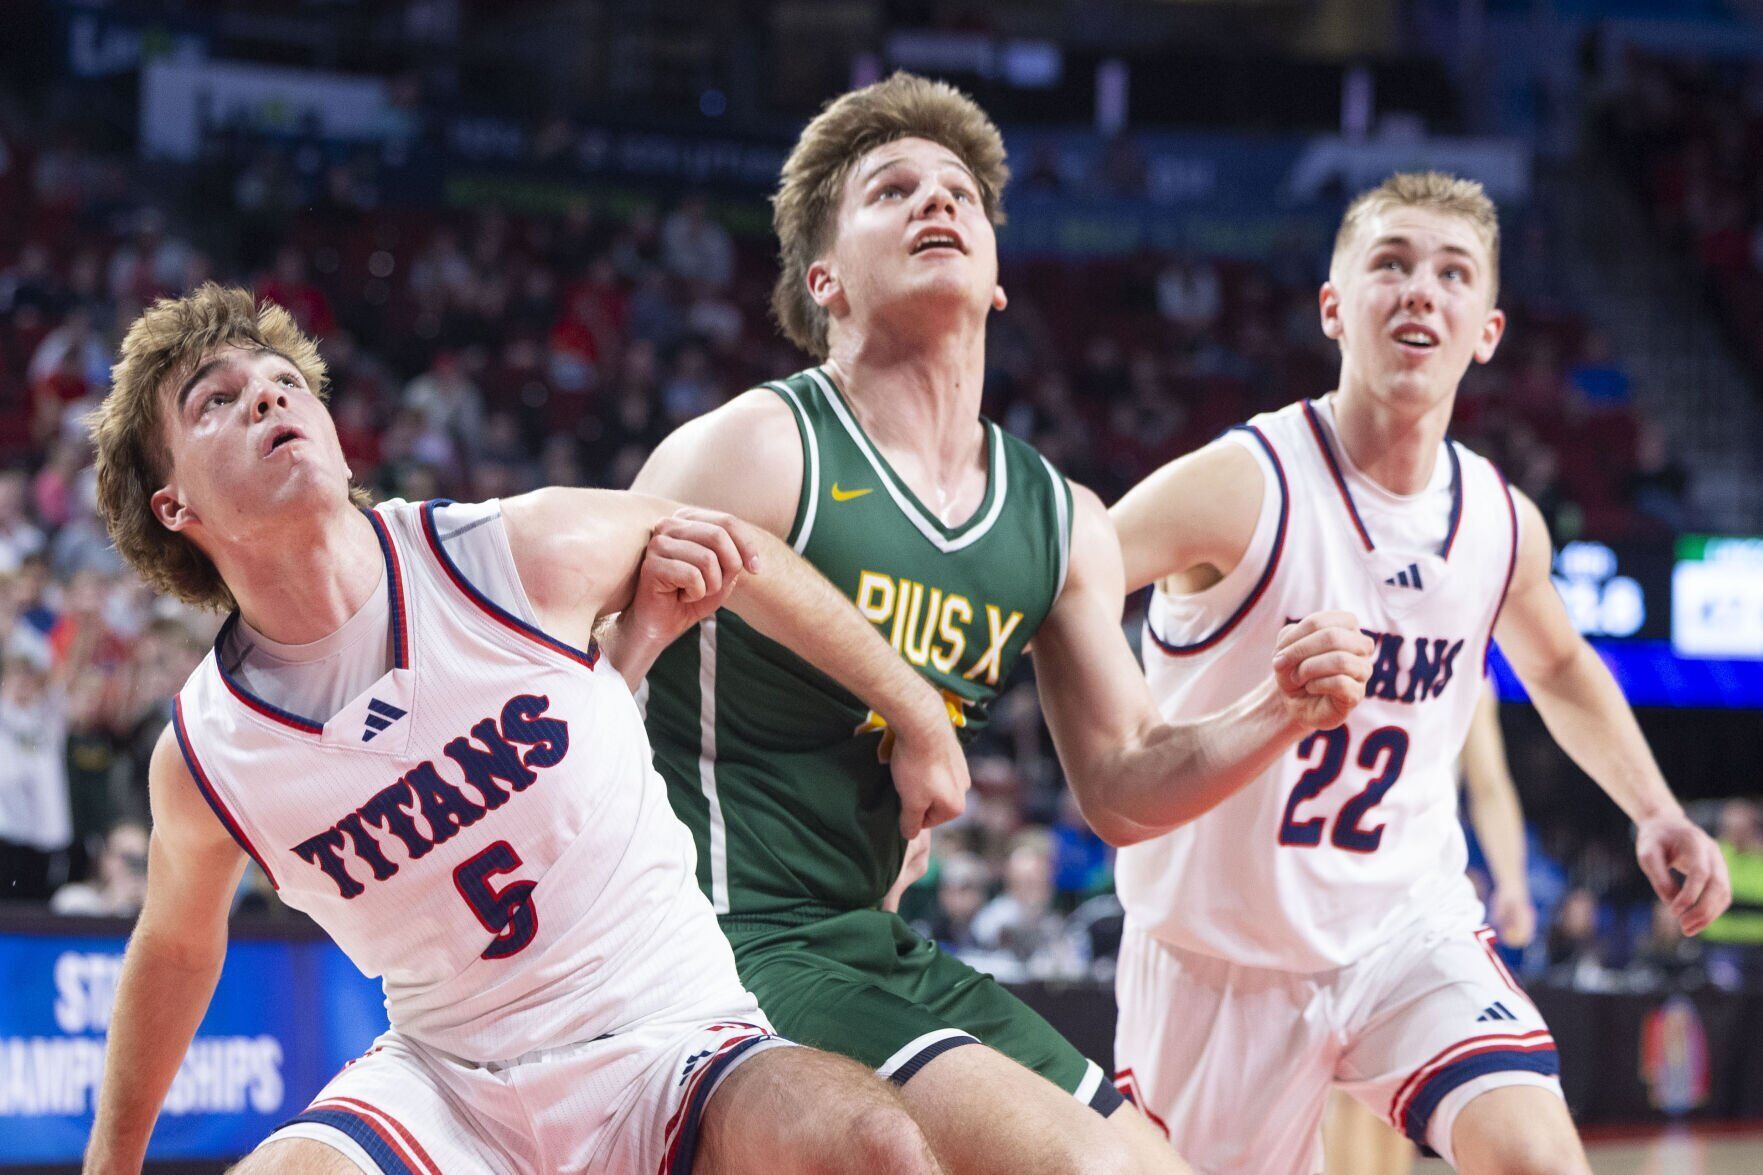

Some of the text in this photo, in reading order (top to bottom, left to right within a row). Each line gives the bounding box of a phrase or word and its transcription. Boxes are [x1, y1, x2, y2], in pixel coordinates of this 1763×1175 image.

[856, 569, 1024, 686] PIUS X
[1284, 616, 1465, 705] ANS
[289, 694, 569, 899] TITANS
[1278, 722, 1410, 854] 22
[452, 840, 539, 960] 5
